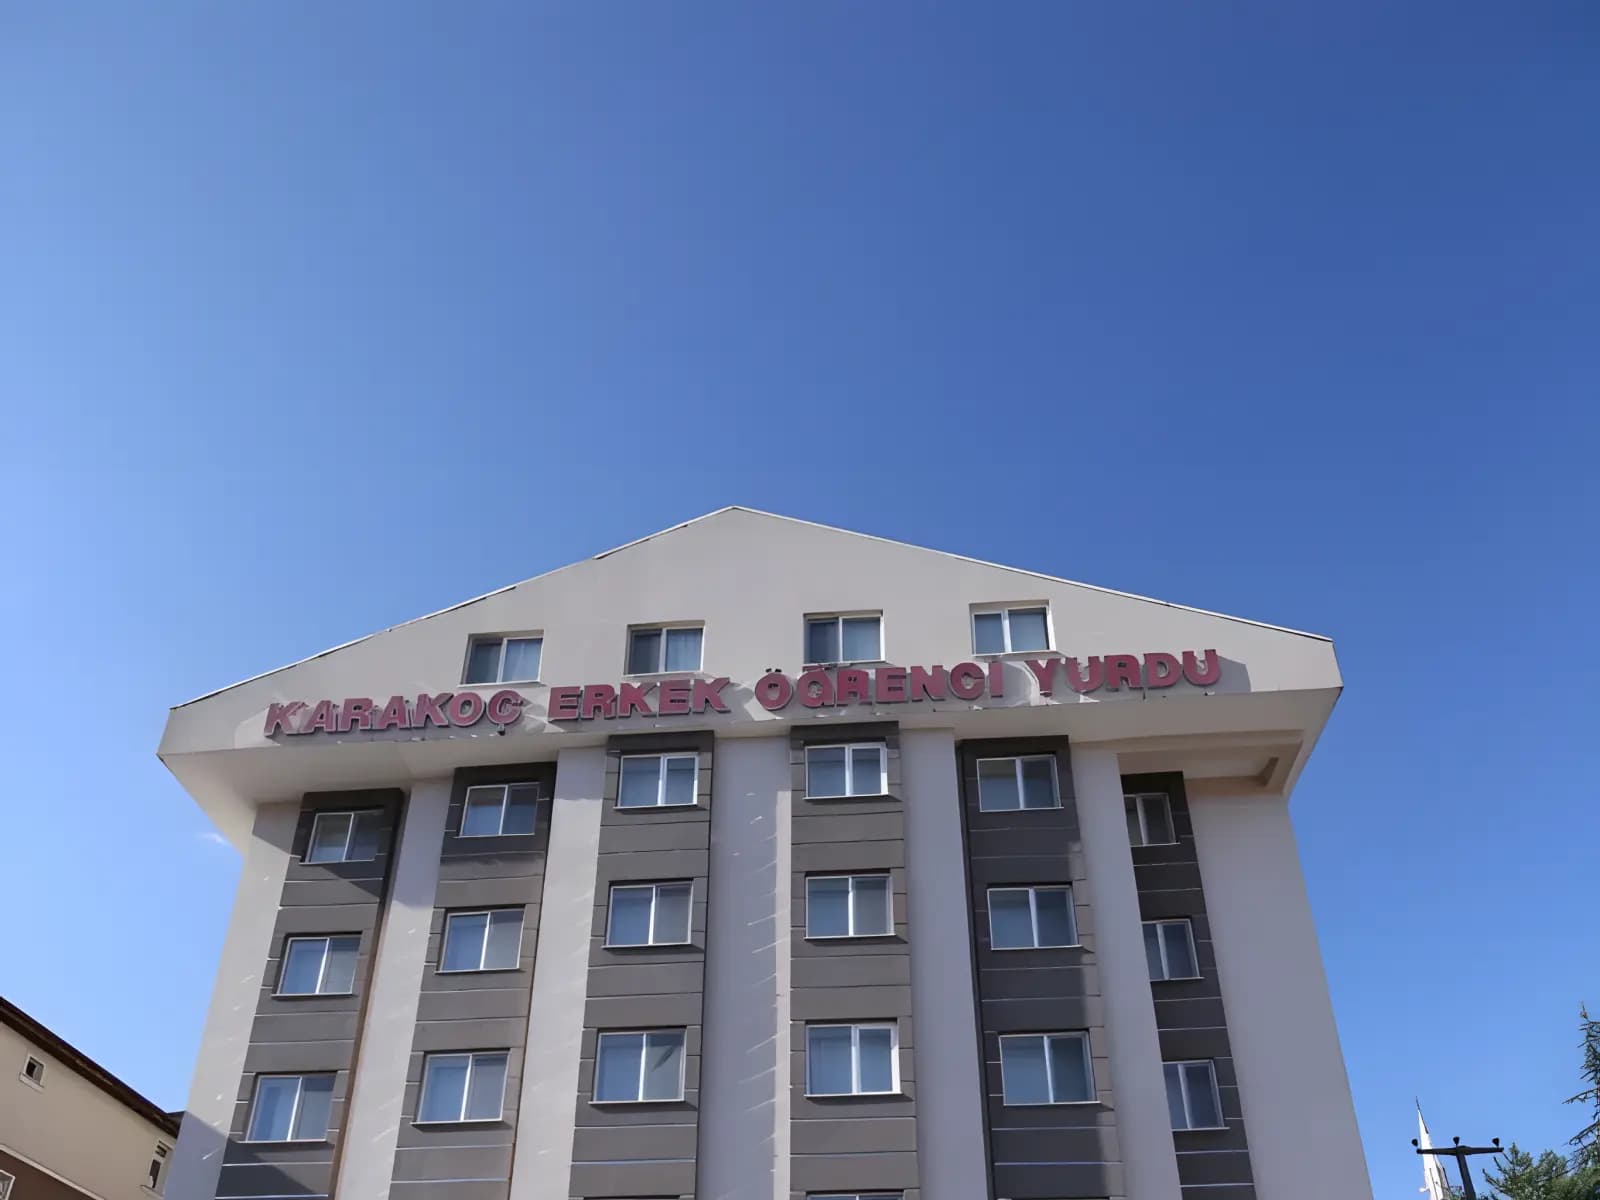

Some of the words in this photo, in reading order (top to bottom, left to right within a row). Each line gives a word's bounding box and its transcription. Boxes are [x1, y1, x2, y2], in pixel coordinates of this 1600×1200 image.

[264, 690, 523, 735] KARAKOÇ
[547, 678, 732, 721] ERKEK
[1024, 649, 1222, 696] YURDU
